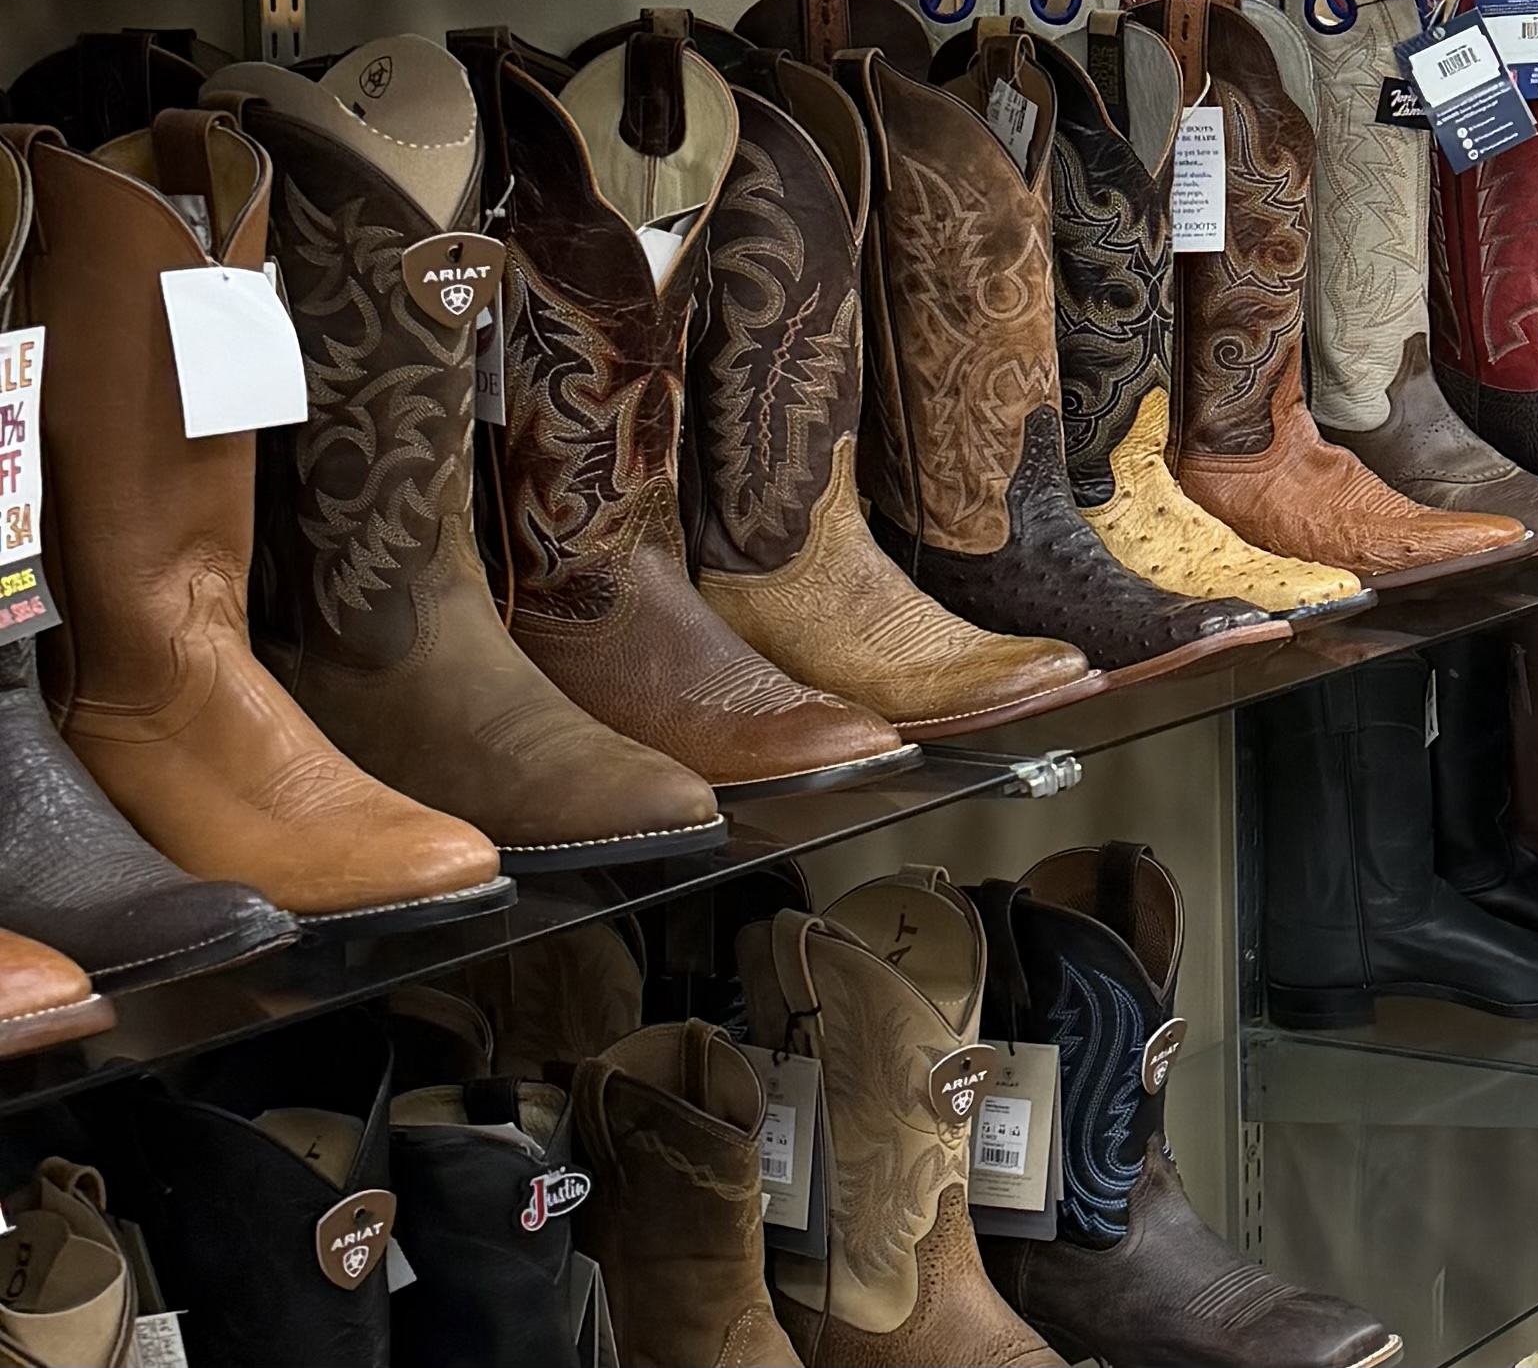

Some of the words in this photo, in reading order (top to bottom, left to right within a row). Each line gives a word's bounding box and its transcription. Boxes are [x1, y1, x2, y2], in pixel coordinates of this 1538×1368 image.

[422, 265, 491, 284] ARIAT
[1149, 1041, 1180, 1068] ARIAT
[941, 1069, 989, 1095] ARIAT
[520, 1178, 587, 1232] Justin
[330, 1222, 385, 1252] ARIAT
